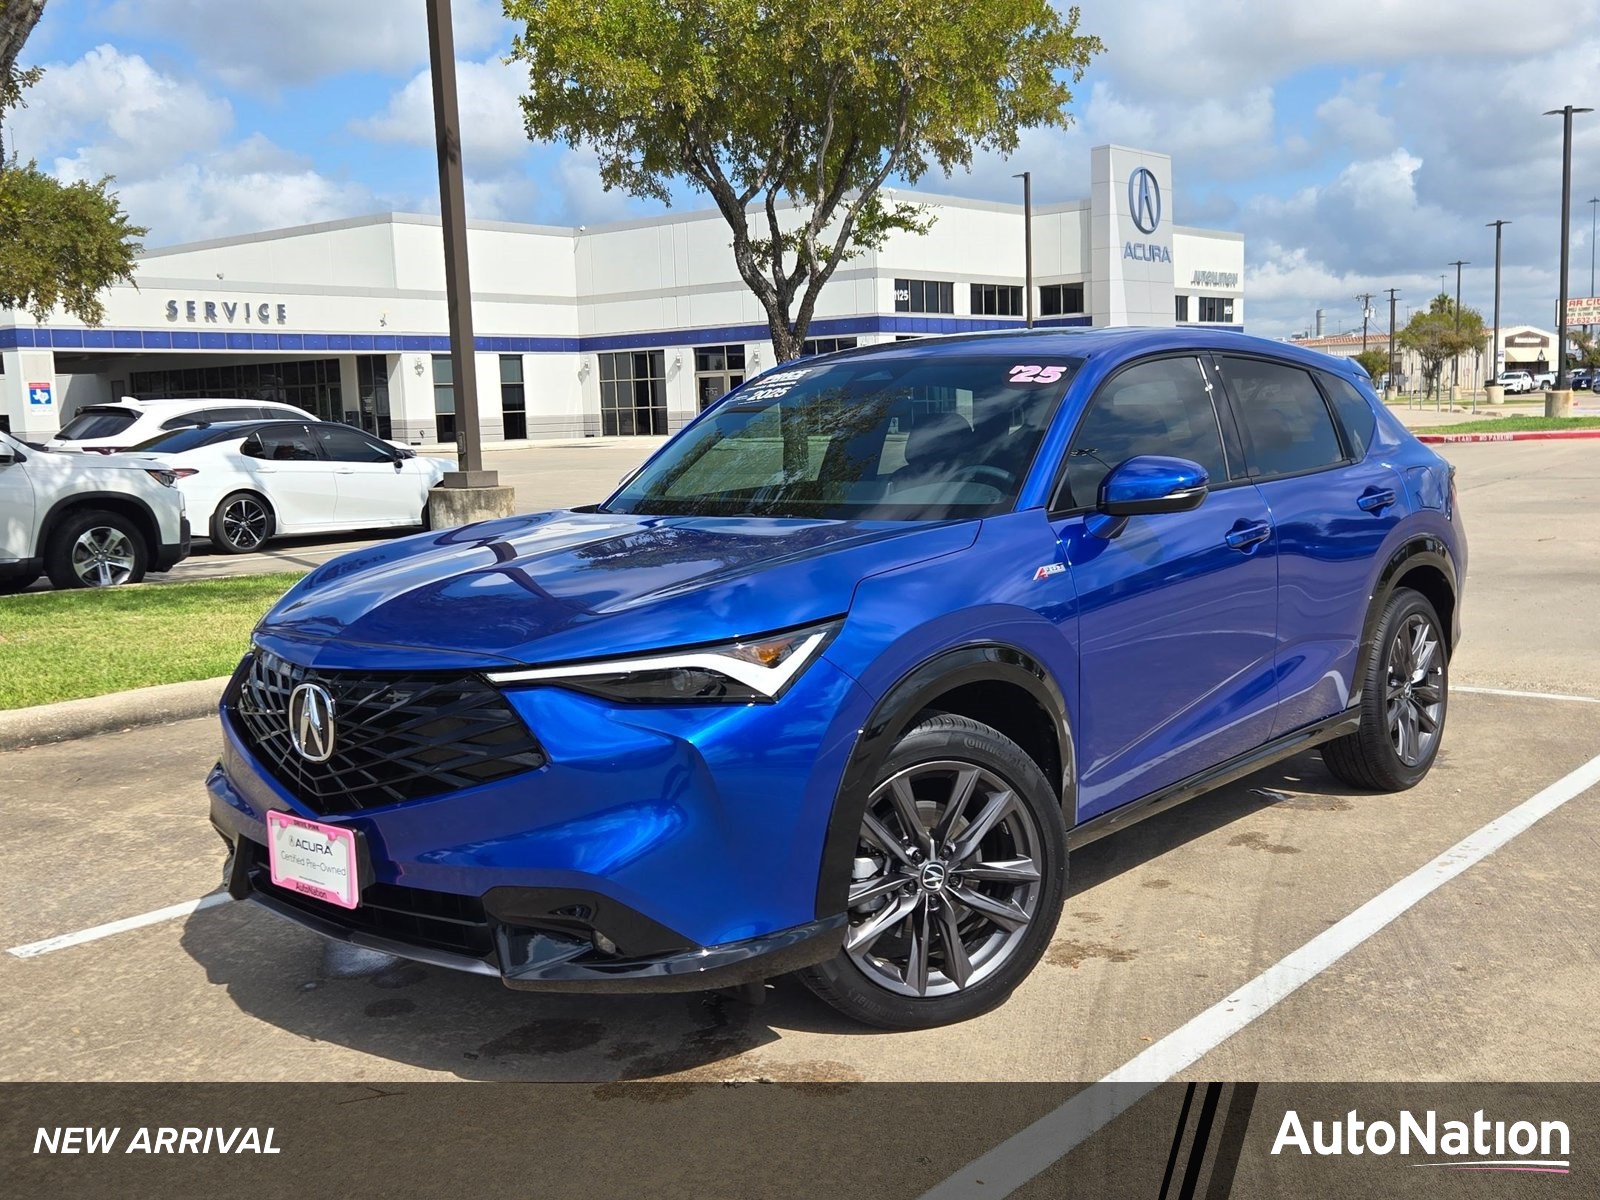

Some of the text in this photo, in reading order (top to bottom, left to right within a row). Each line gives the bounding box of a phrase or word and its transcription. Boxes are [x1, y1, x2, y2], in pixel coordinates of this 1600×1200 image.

[1124, 241, 1171, 263] ACURA
[166, 299, 287, 322] SERVICE
[295, 838, 333, 857] ACURA
[280, 850, 347, 877] Certified Pre-Owned
[295, 882, 328, 899] AutoNation
